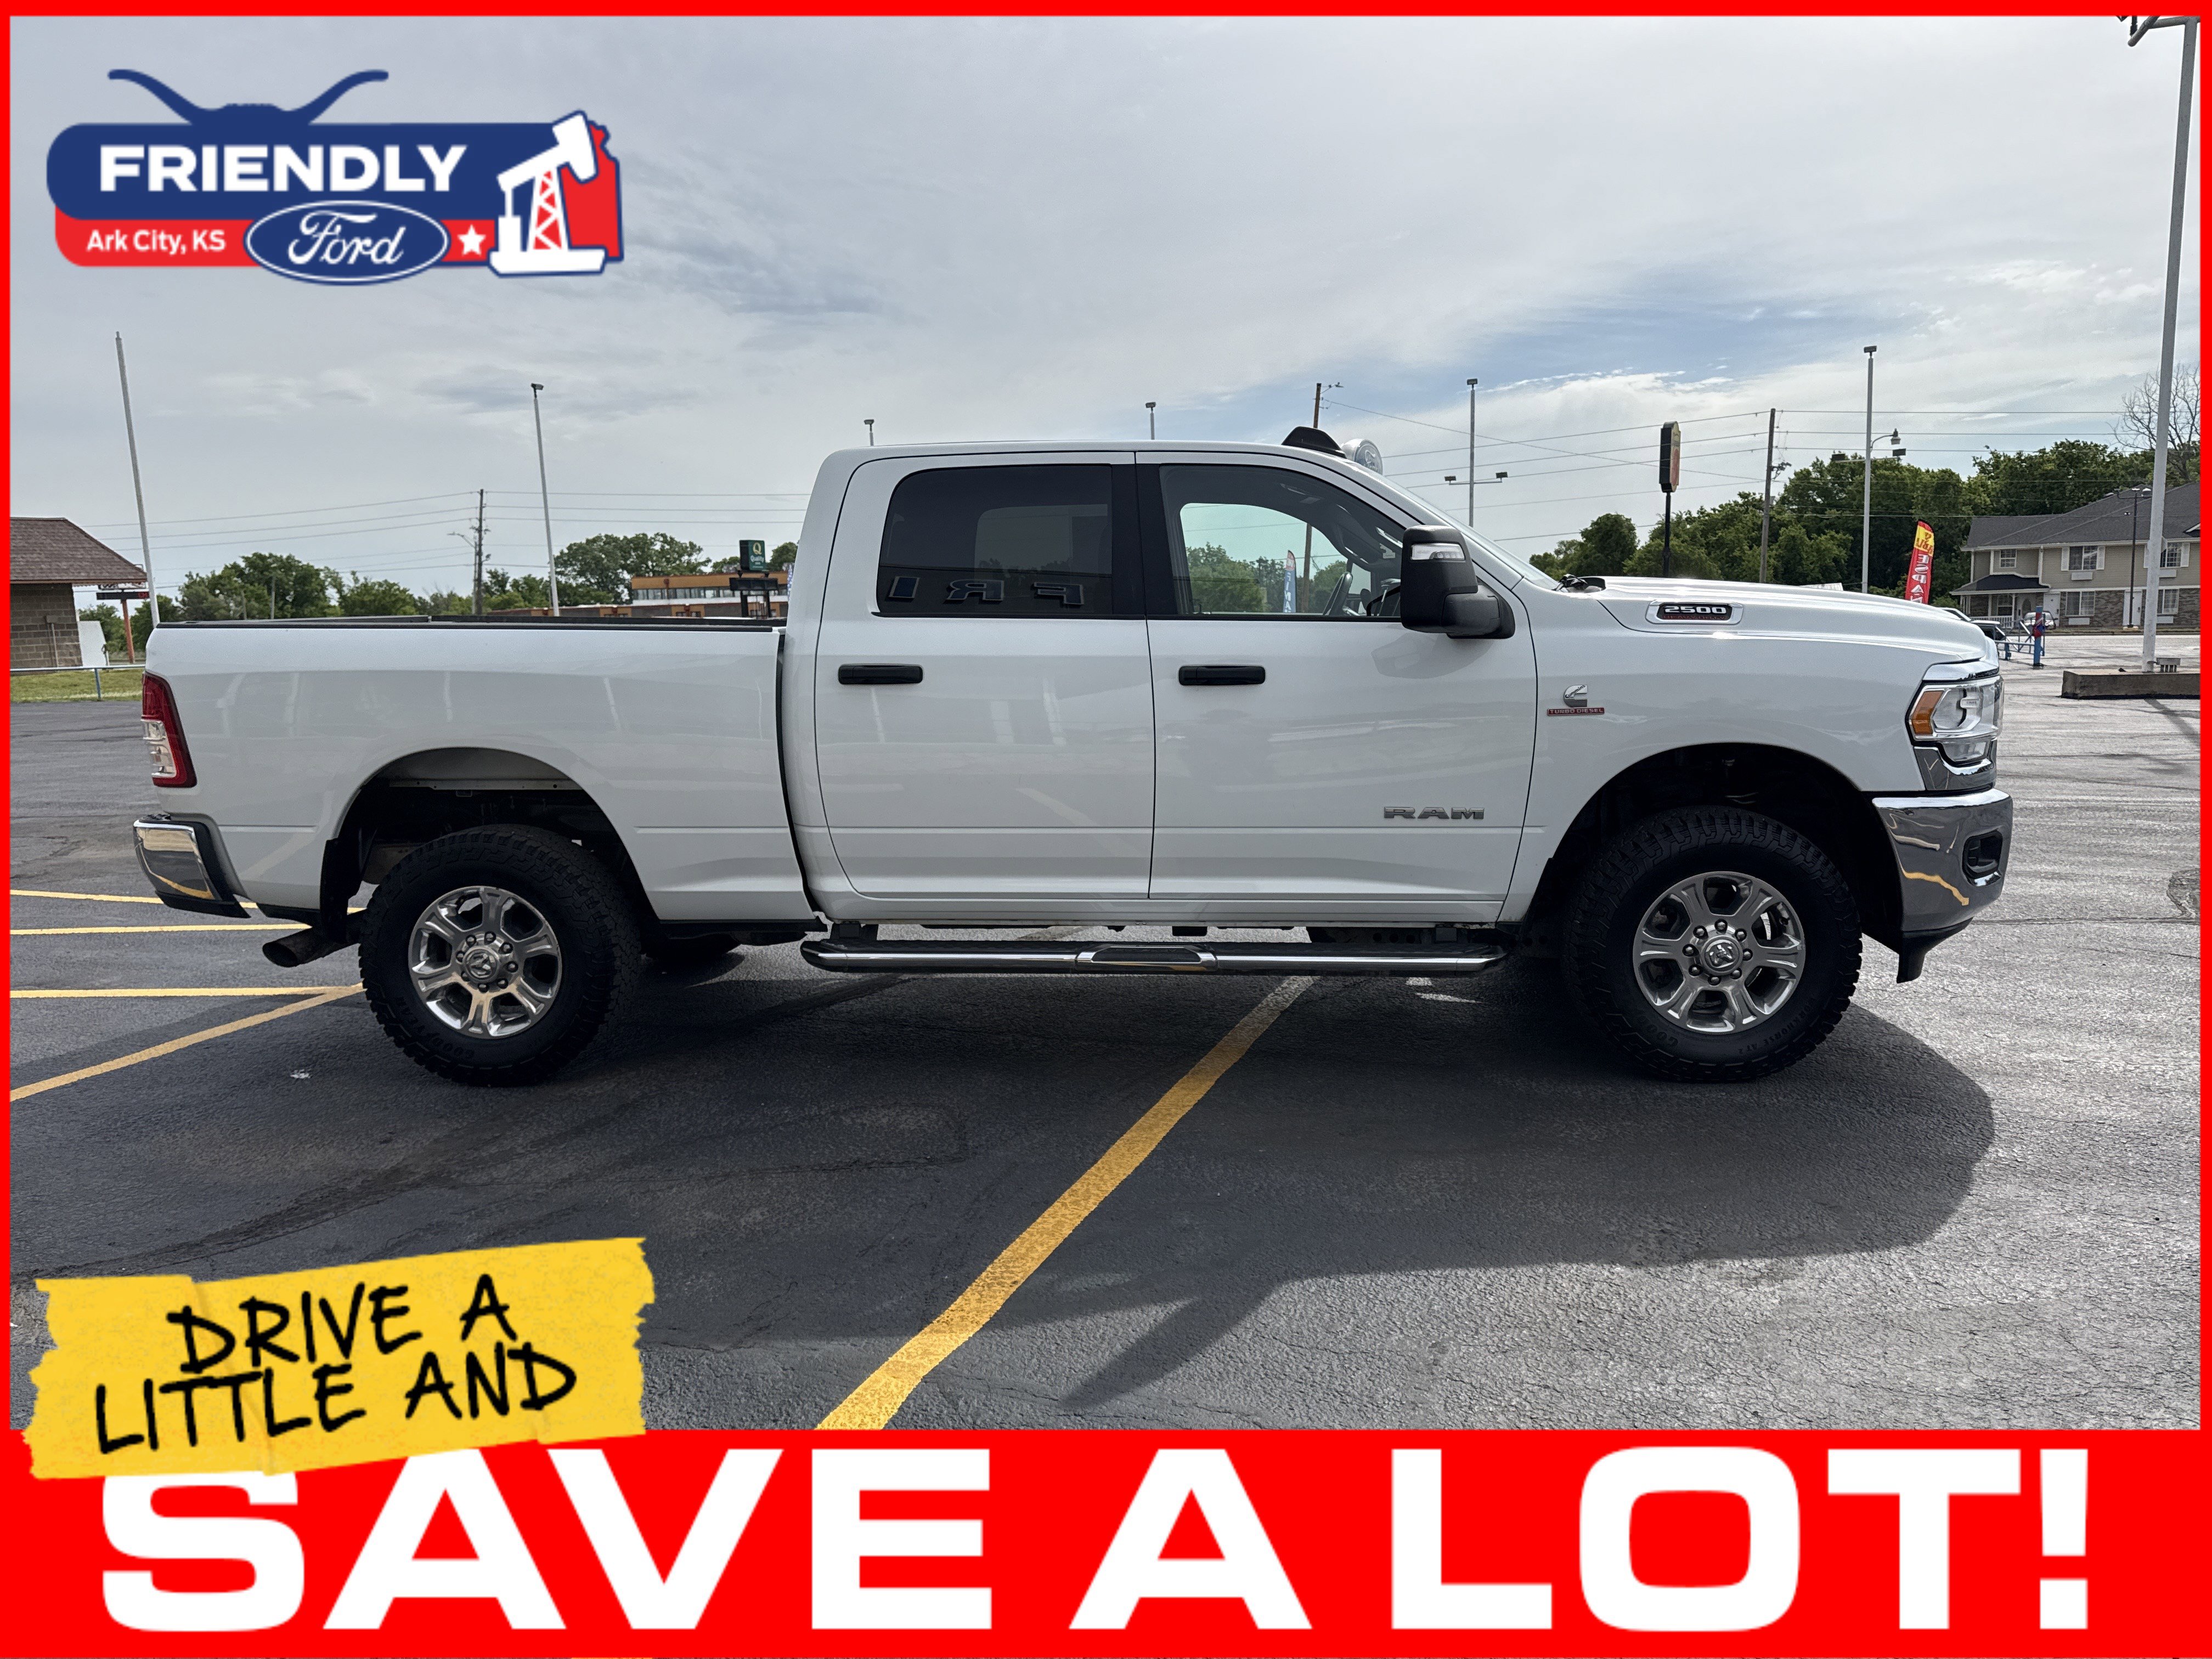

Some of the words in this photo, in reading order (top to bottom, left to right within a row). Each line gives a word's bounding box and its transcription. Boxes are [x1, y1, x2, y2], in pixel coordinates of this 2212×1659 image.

[1664, 606, 1726, 614] 2500
[1565, 684, 1586, 698] Cummins
[1384, 806, 1485, 820] RAM
